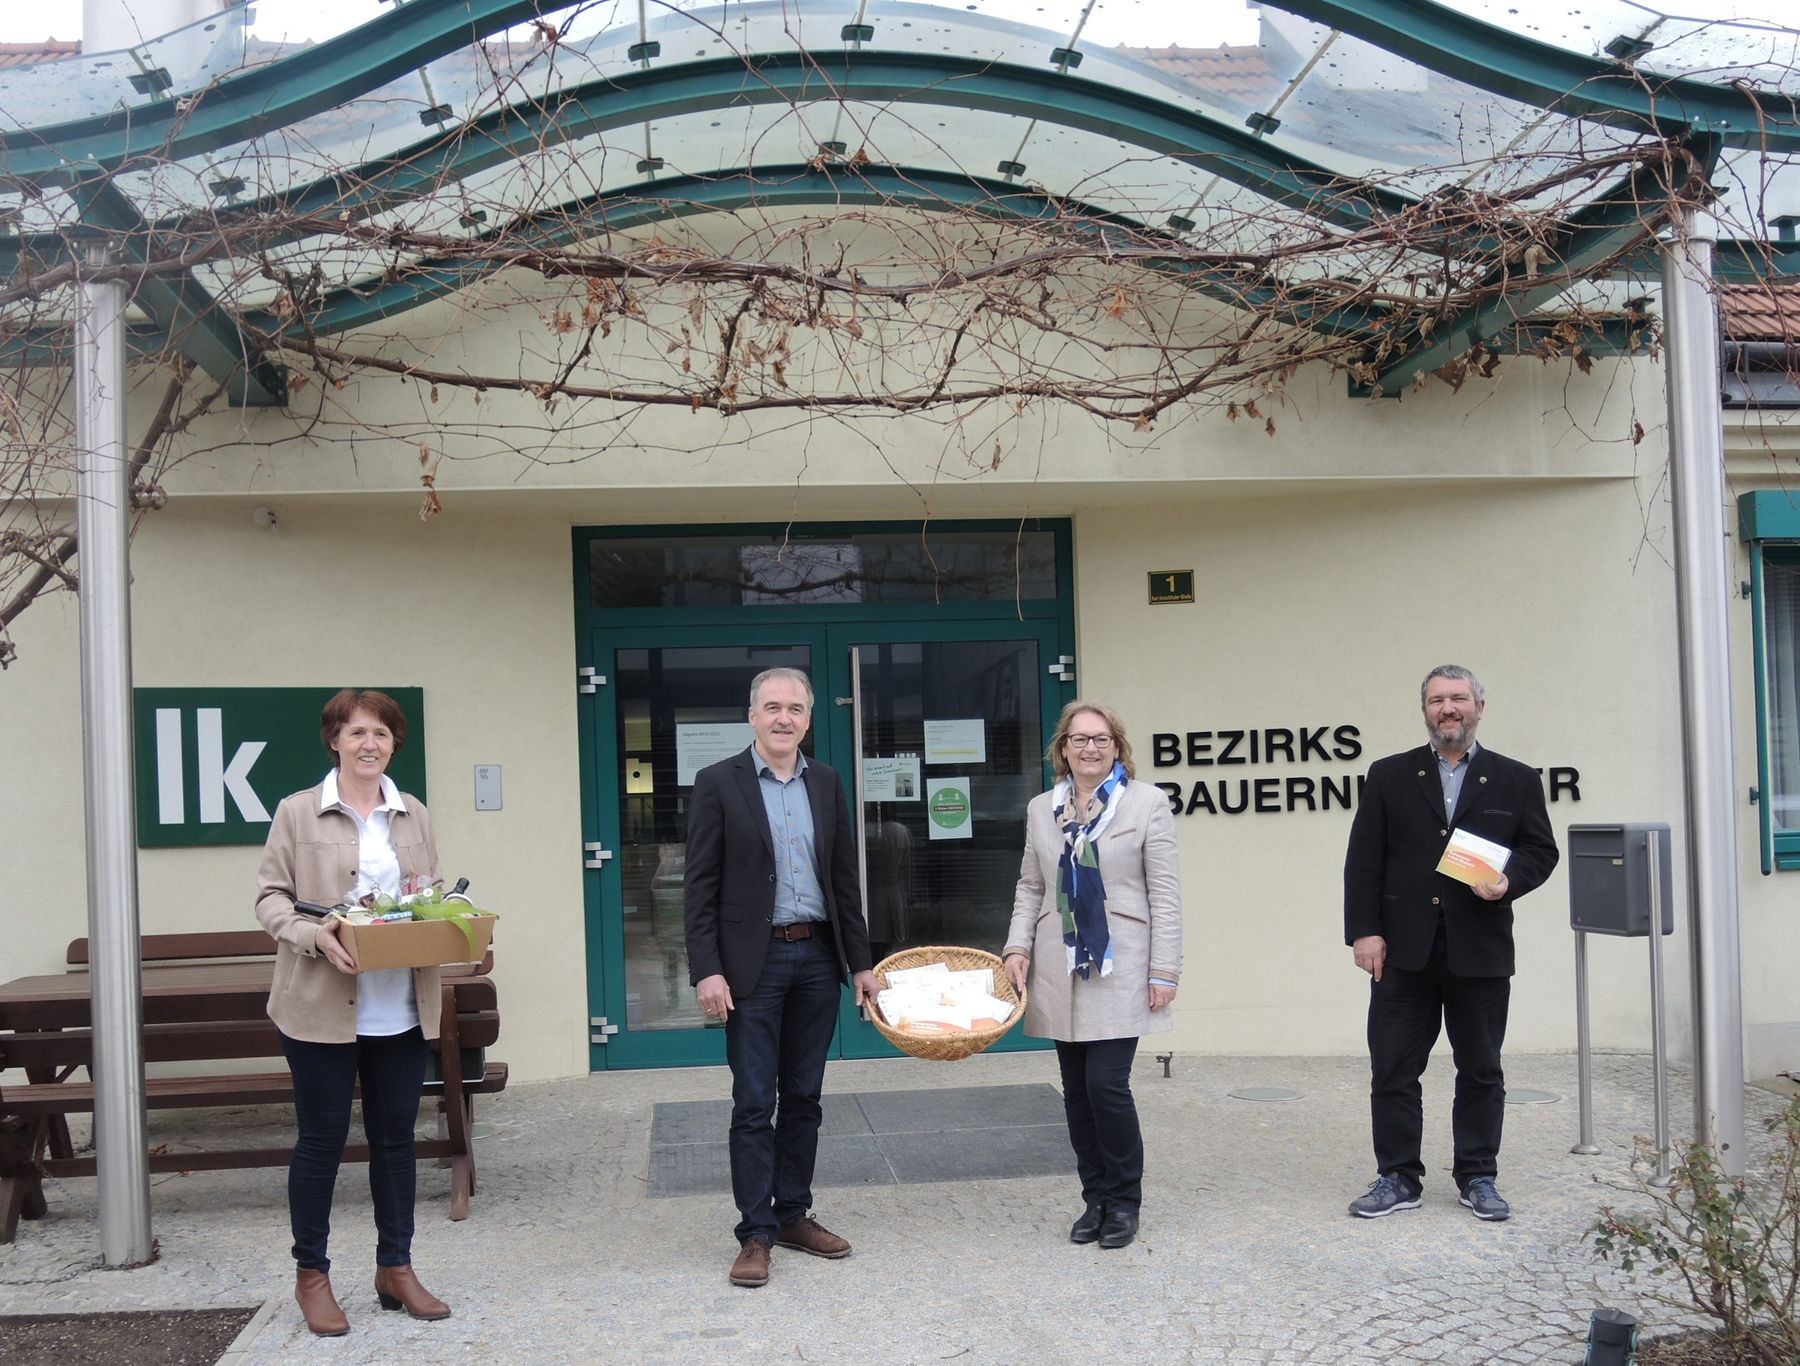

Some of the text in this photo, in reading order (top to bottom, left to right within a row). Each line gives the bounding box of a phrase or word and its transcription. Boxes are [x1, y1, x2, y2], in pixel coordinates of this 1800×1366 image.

[1165, 575, 1176, 593] 1
[155, 707, 273, 825] lk
[1152, 724, 1362, 768] BEZIRKS
